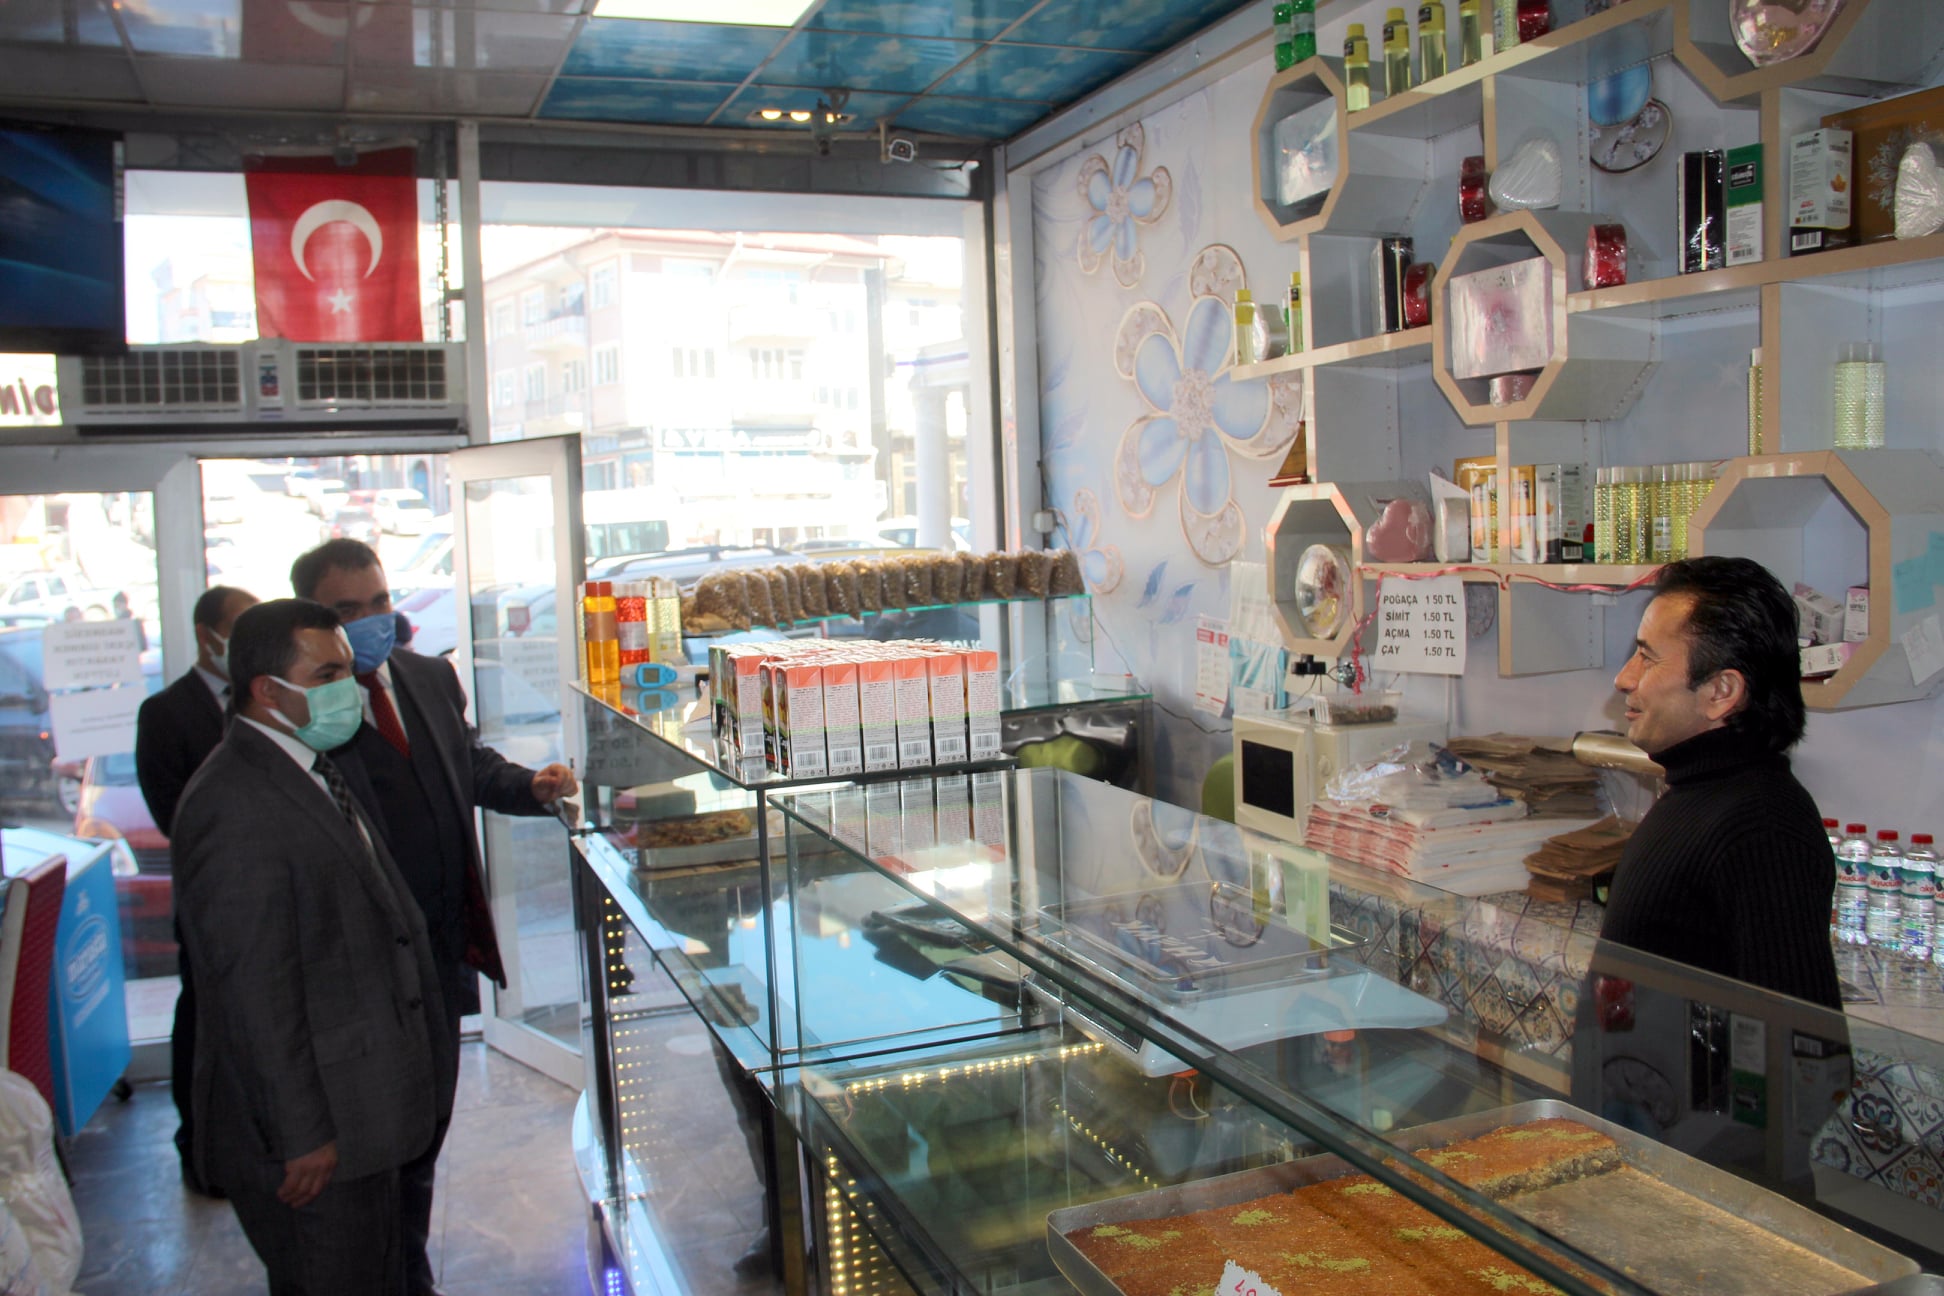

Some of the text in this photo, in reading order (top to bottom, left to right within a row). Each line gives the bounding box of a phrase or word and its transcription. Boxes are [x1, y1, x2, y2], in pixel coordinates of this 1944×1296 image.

[1445, 594, 1457, 605] TL
[1385, 610, 1455, 622] SİMİT 1.50 TL
[1384, 628, 1455, 639] AÇMA 1.50 TL
[1381, 644, 1456, 657] ÇAY 1.50 TL
